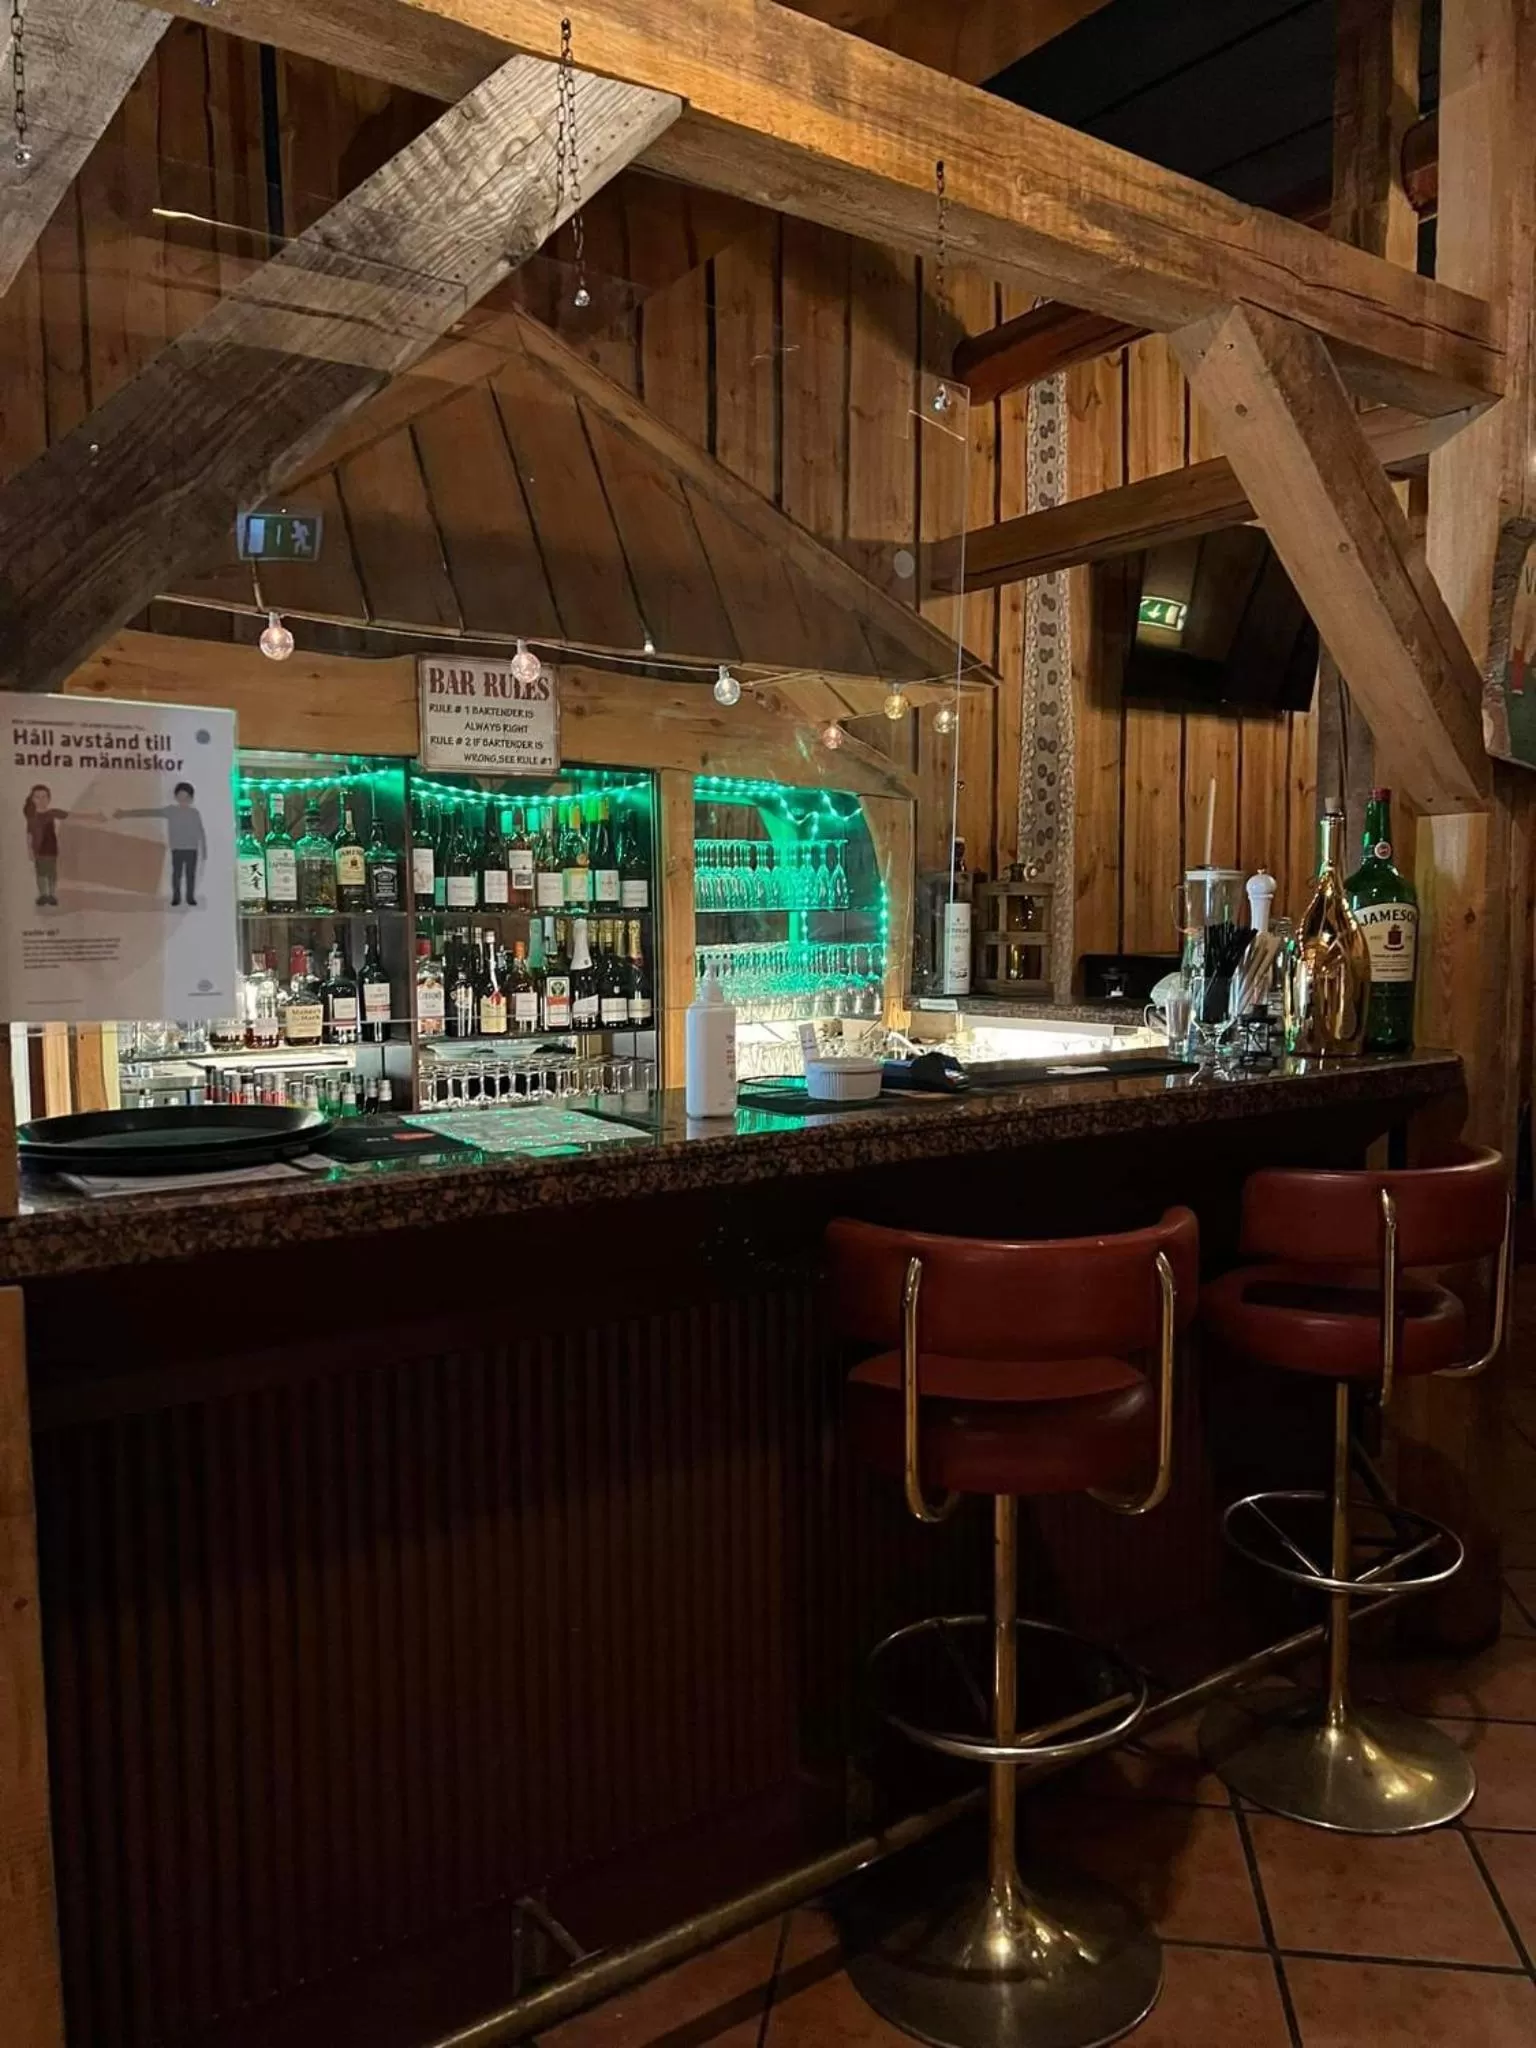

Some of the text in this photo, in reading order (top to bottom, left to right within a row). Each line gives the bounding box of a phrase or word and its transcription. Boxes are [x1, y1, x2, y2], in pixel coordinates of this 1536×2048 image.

[428, 667, 550, 701] BAR RULES
[428, 703, 451, 713] RULE
[472, 705, 525, 718] BARTENDER
[464, 721, 529, 734] ALWAYS RIGHT
[13, 728, 172, 751] Håll avstånd till
[430, 735, 454, 745] RULE
[465, 737, 471, 747] 2
[473, 737, 481, 747] IF
[482, 737, 533, 749] BARTENDER
[535, 740, 544, 750] IS
[14, 750, 184, 772] andra människor
[517, 756, 538, 765] RULE
[1360, 908, 1415, 926] JAMESO
